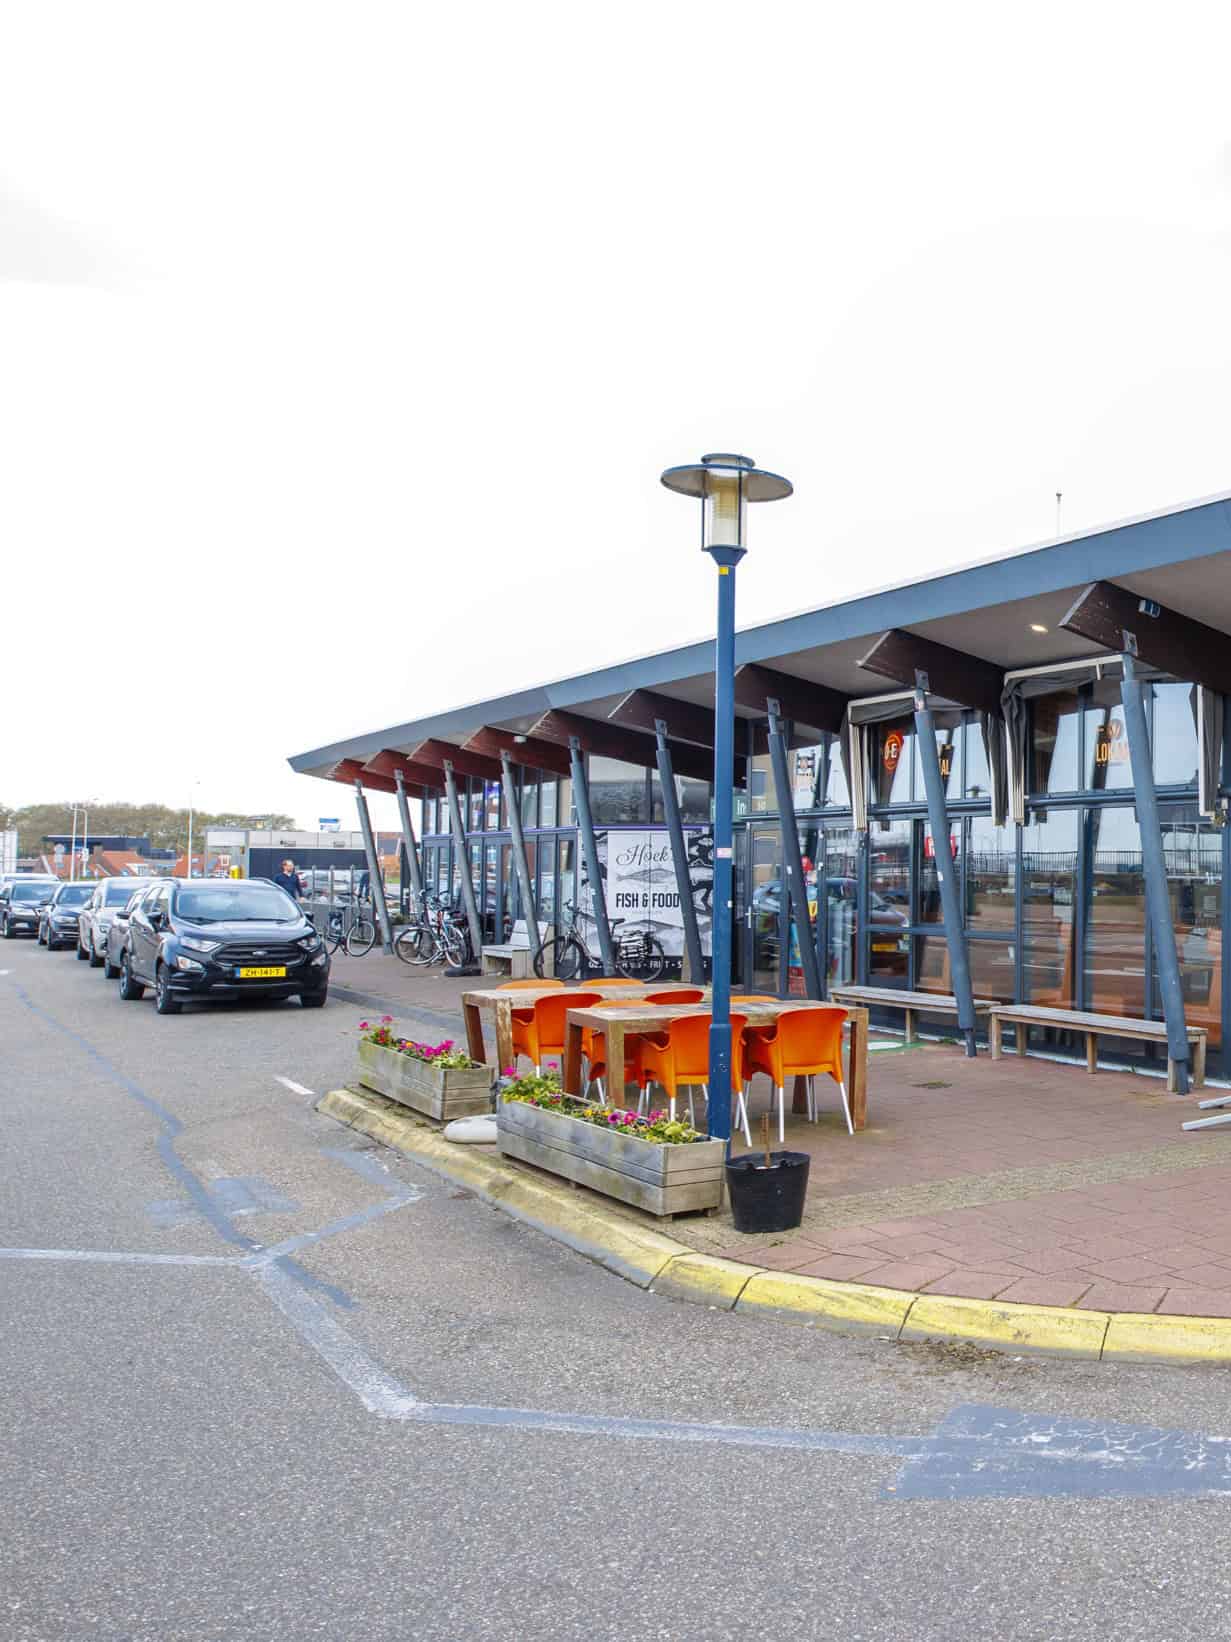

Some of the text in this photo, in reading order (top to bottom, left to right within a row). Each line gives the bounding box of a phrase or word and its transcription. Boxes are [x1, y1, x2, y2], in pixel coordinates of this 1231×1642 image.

[615, 892, 680, 908] FISH & FOOD
